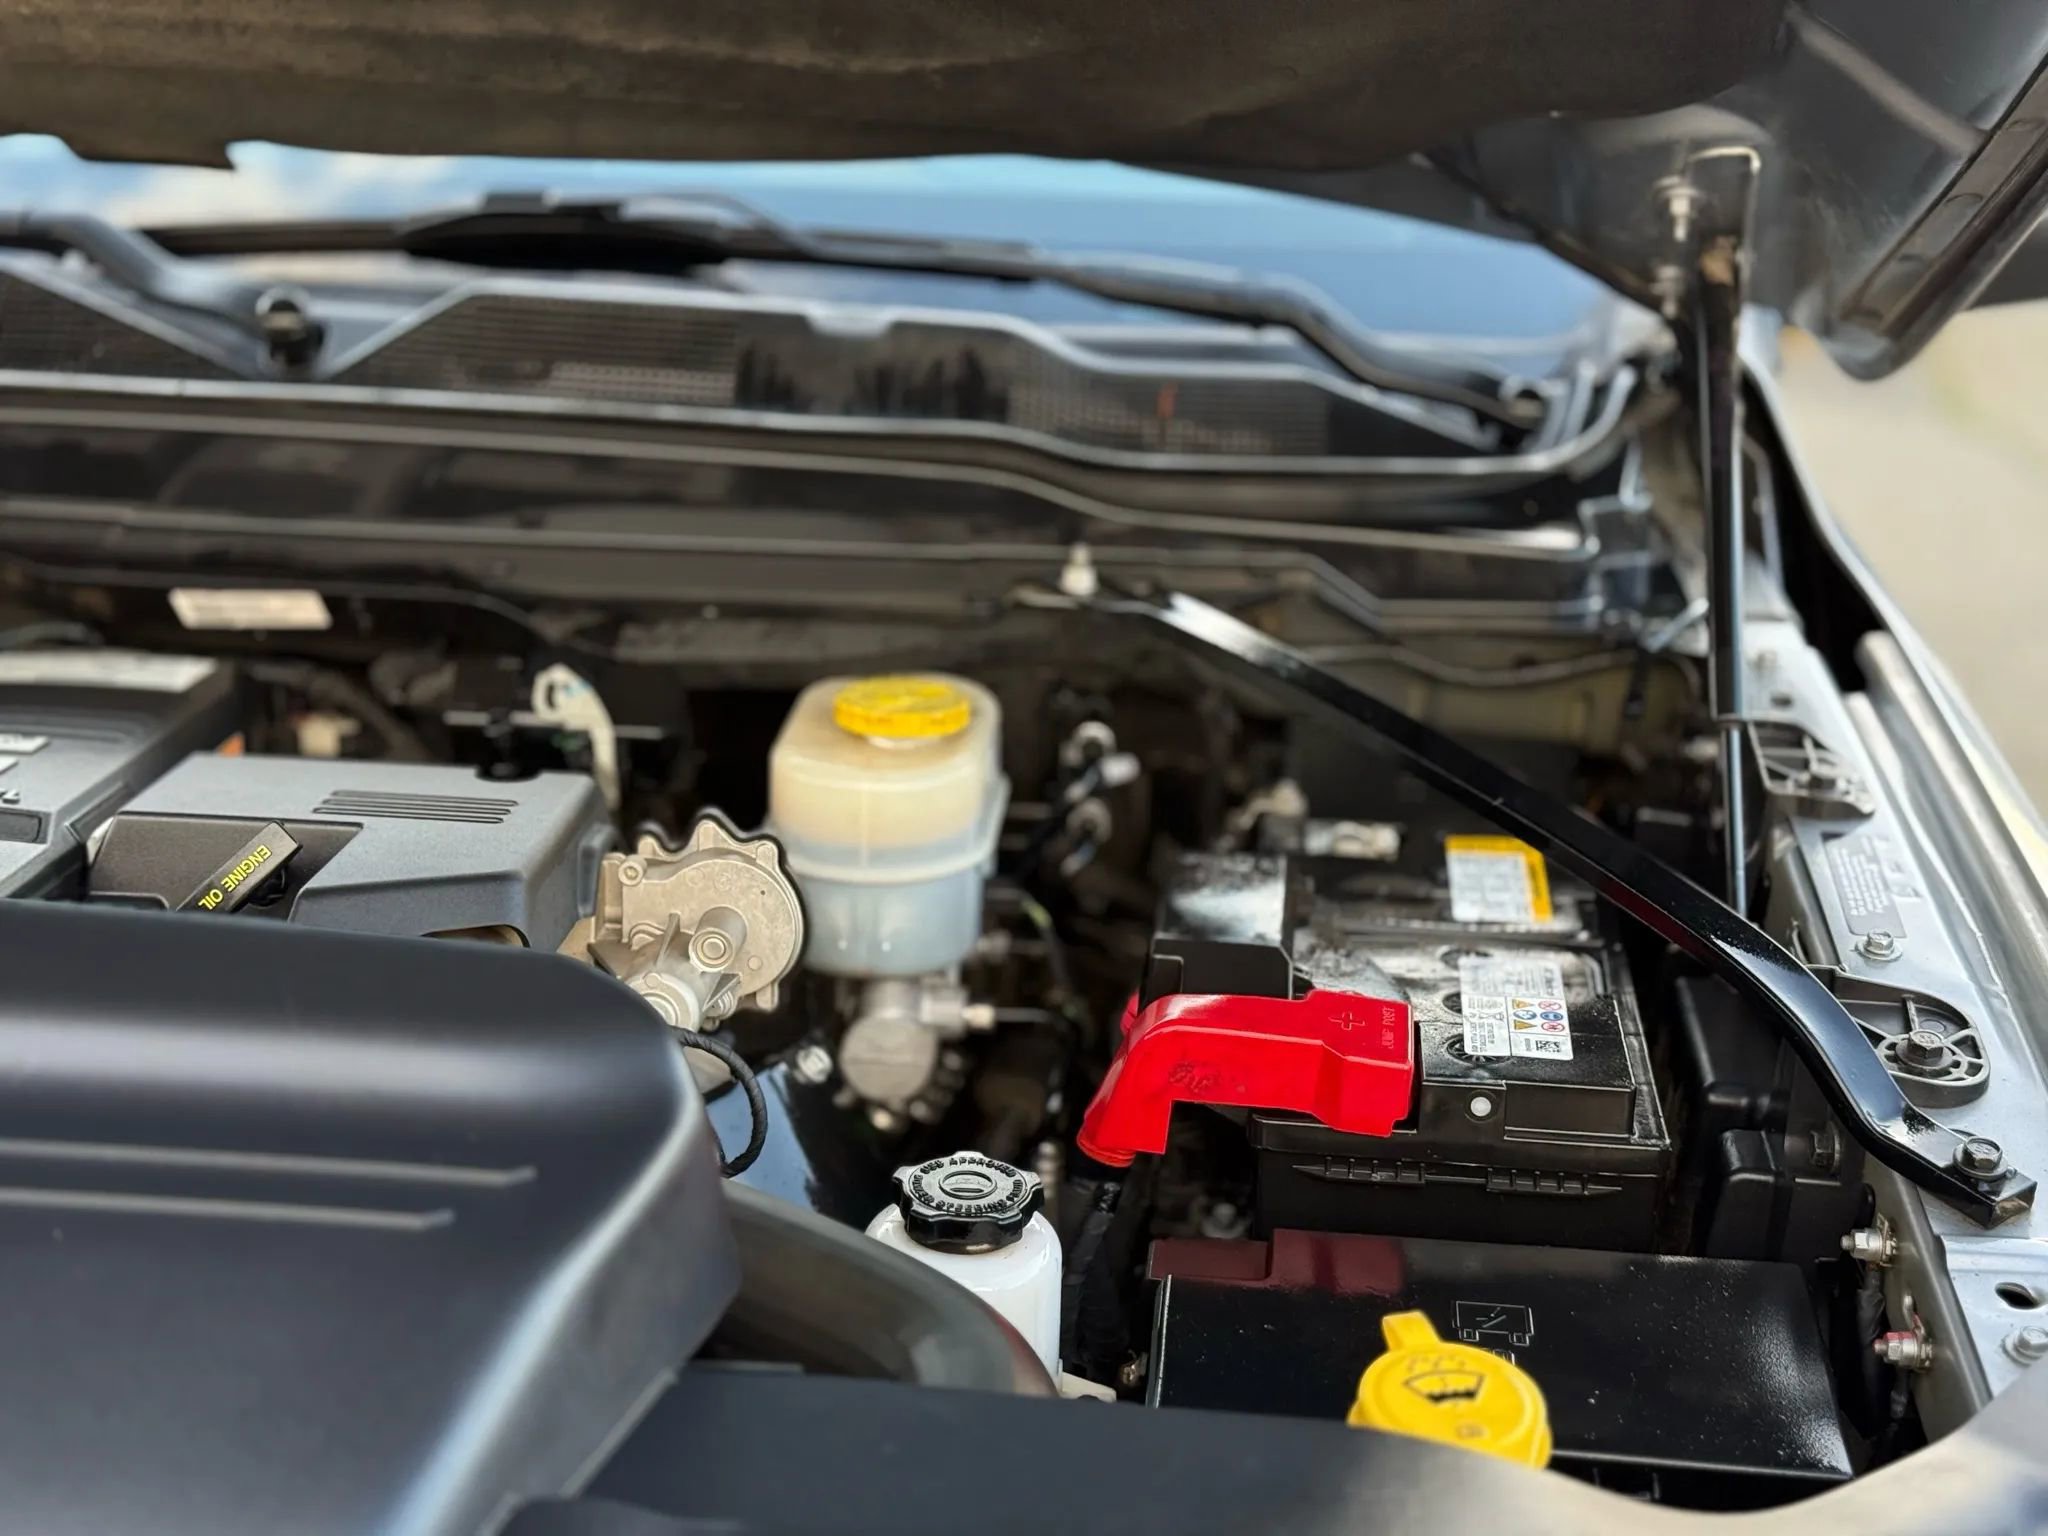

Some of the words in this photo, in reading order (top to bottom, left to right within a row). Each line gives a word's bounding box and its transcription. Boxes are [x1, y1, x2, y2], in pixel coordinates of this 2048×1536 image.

[220, 844, 272, 892] ENGINE
[197, 888, 224, 911] OIL
[1381, 1006, 1396, 1026] POST
[949, 1156, 1017, 1178] APPROVED
